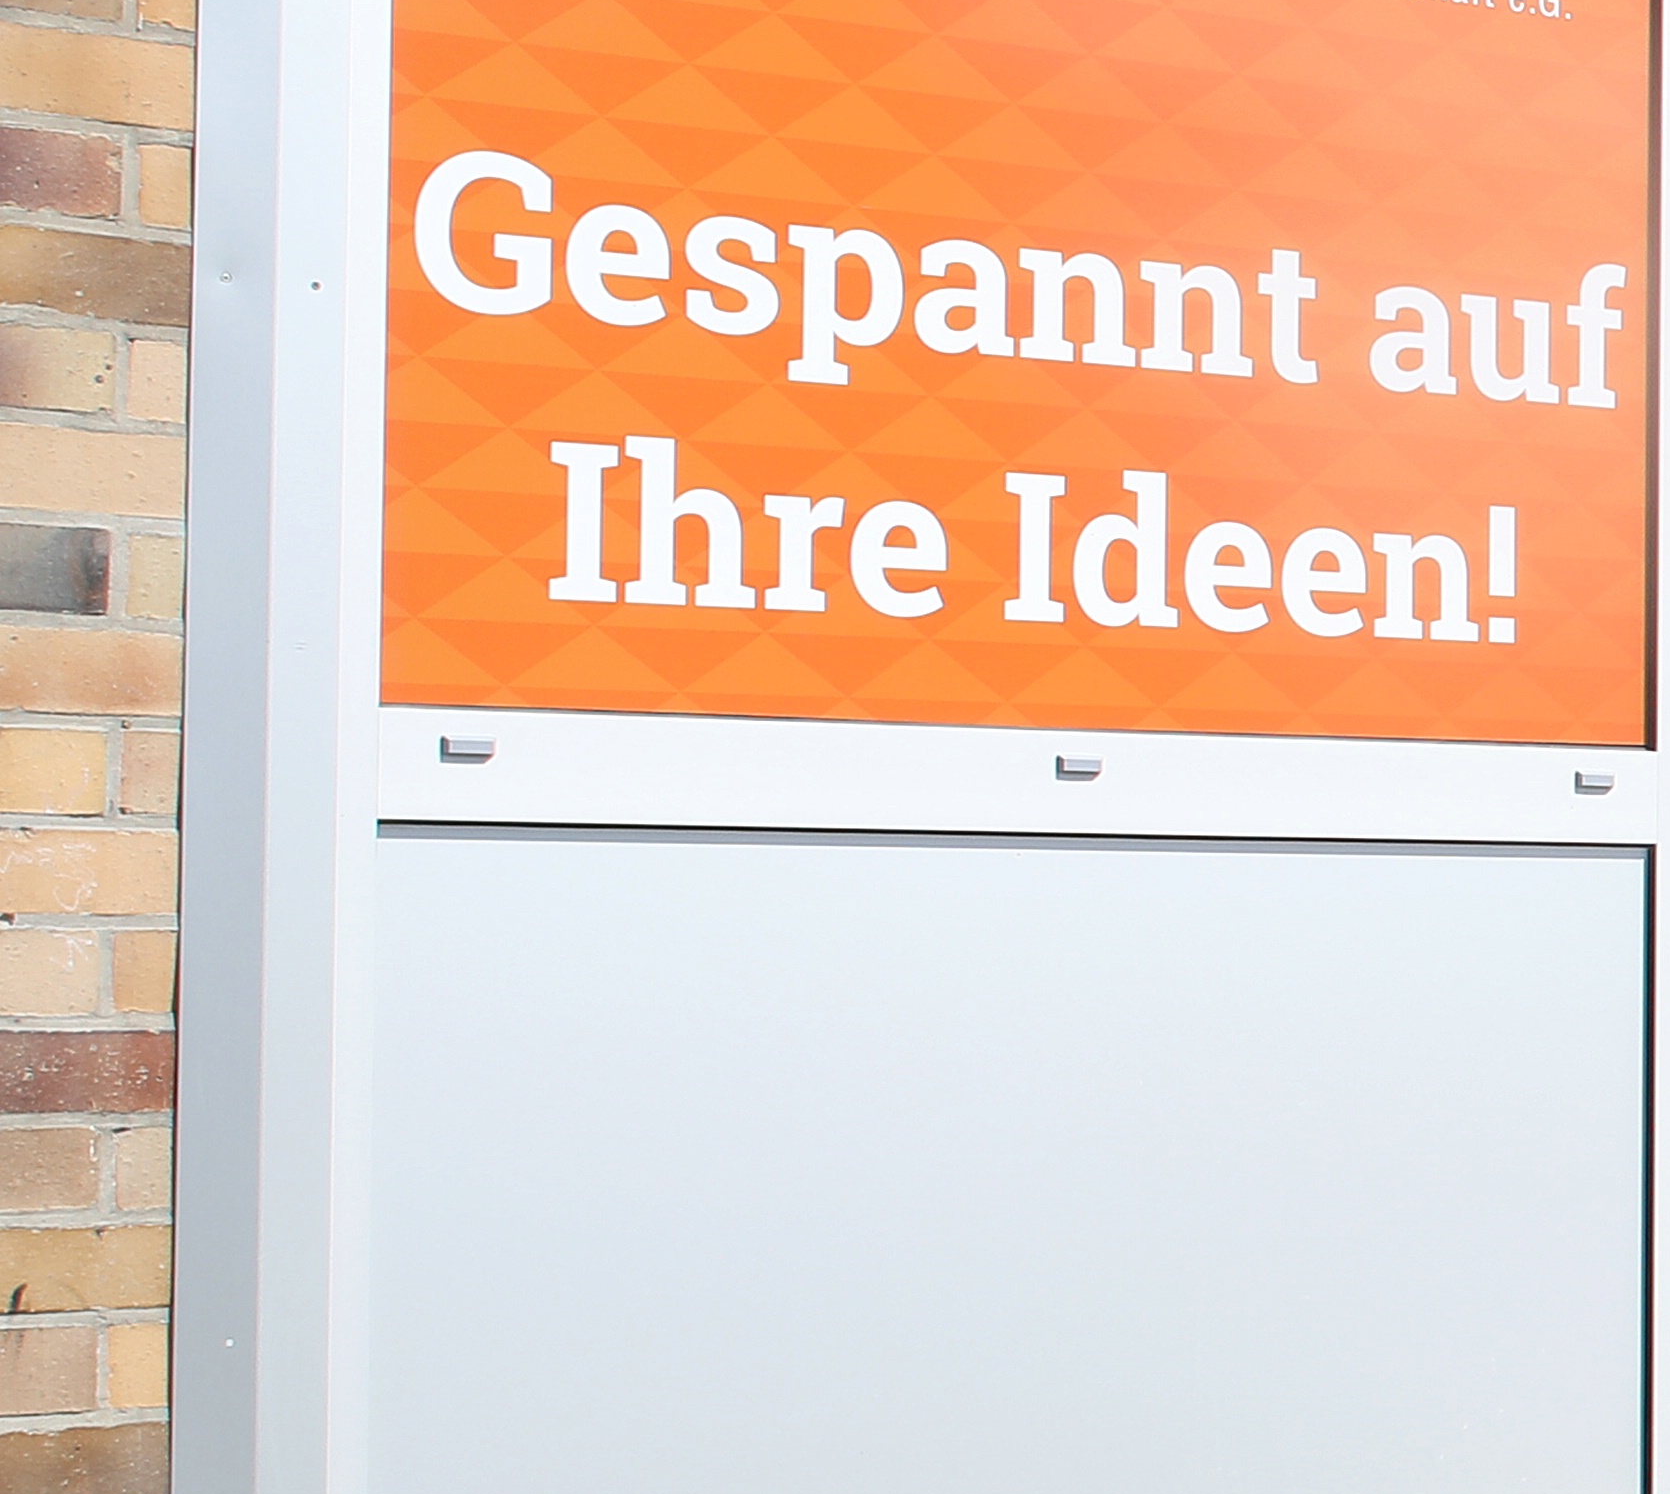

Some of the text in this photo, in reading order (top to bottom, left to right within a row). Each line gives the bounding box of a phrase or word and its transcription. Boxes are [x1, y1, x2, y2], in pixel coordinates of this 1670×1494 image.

[414, 150, 1628, 408] Gespannt auf
[548, 435, 1516, 644] Ihre Ideen!
